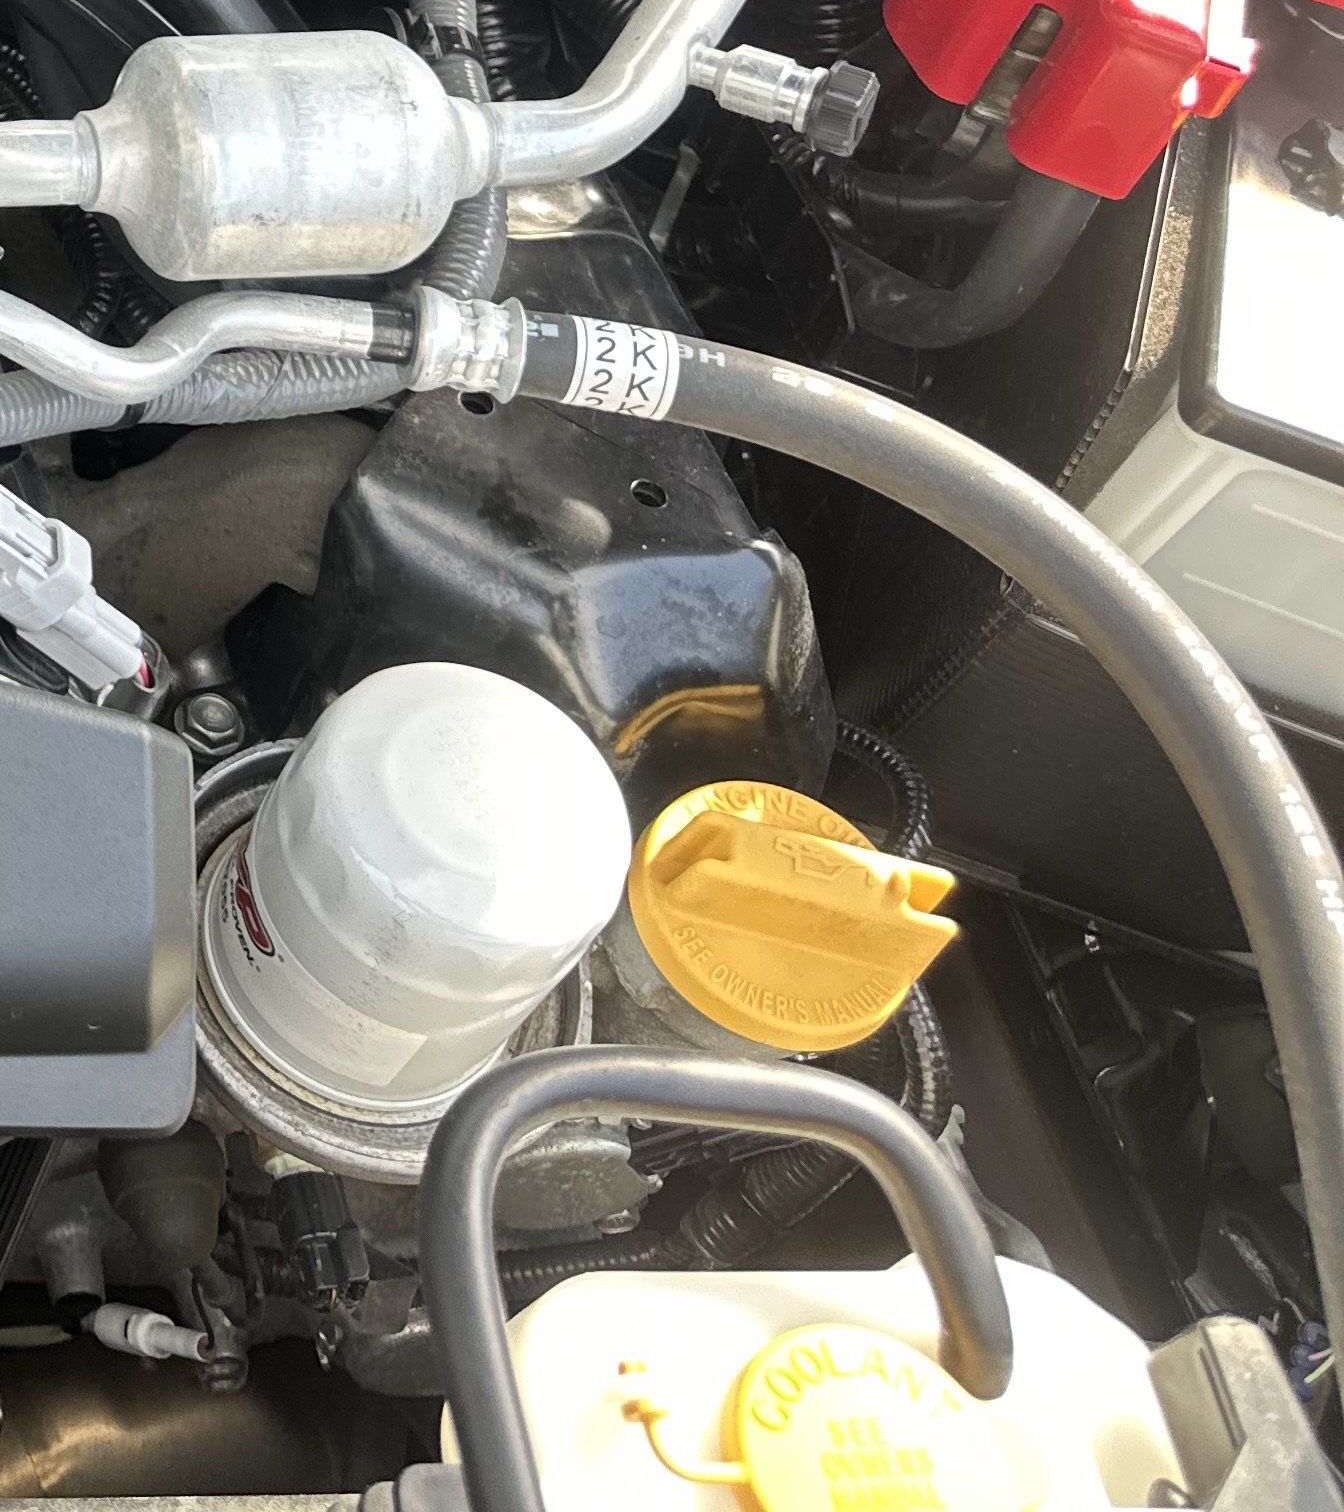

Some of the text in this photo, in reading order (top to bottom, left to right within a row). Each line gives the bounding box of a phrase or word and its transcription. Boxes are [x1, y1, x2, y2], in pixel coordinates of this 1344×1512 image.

[673, 924, 902, 1027] SEE OWNER'S MANUAL
